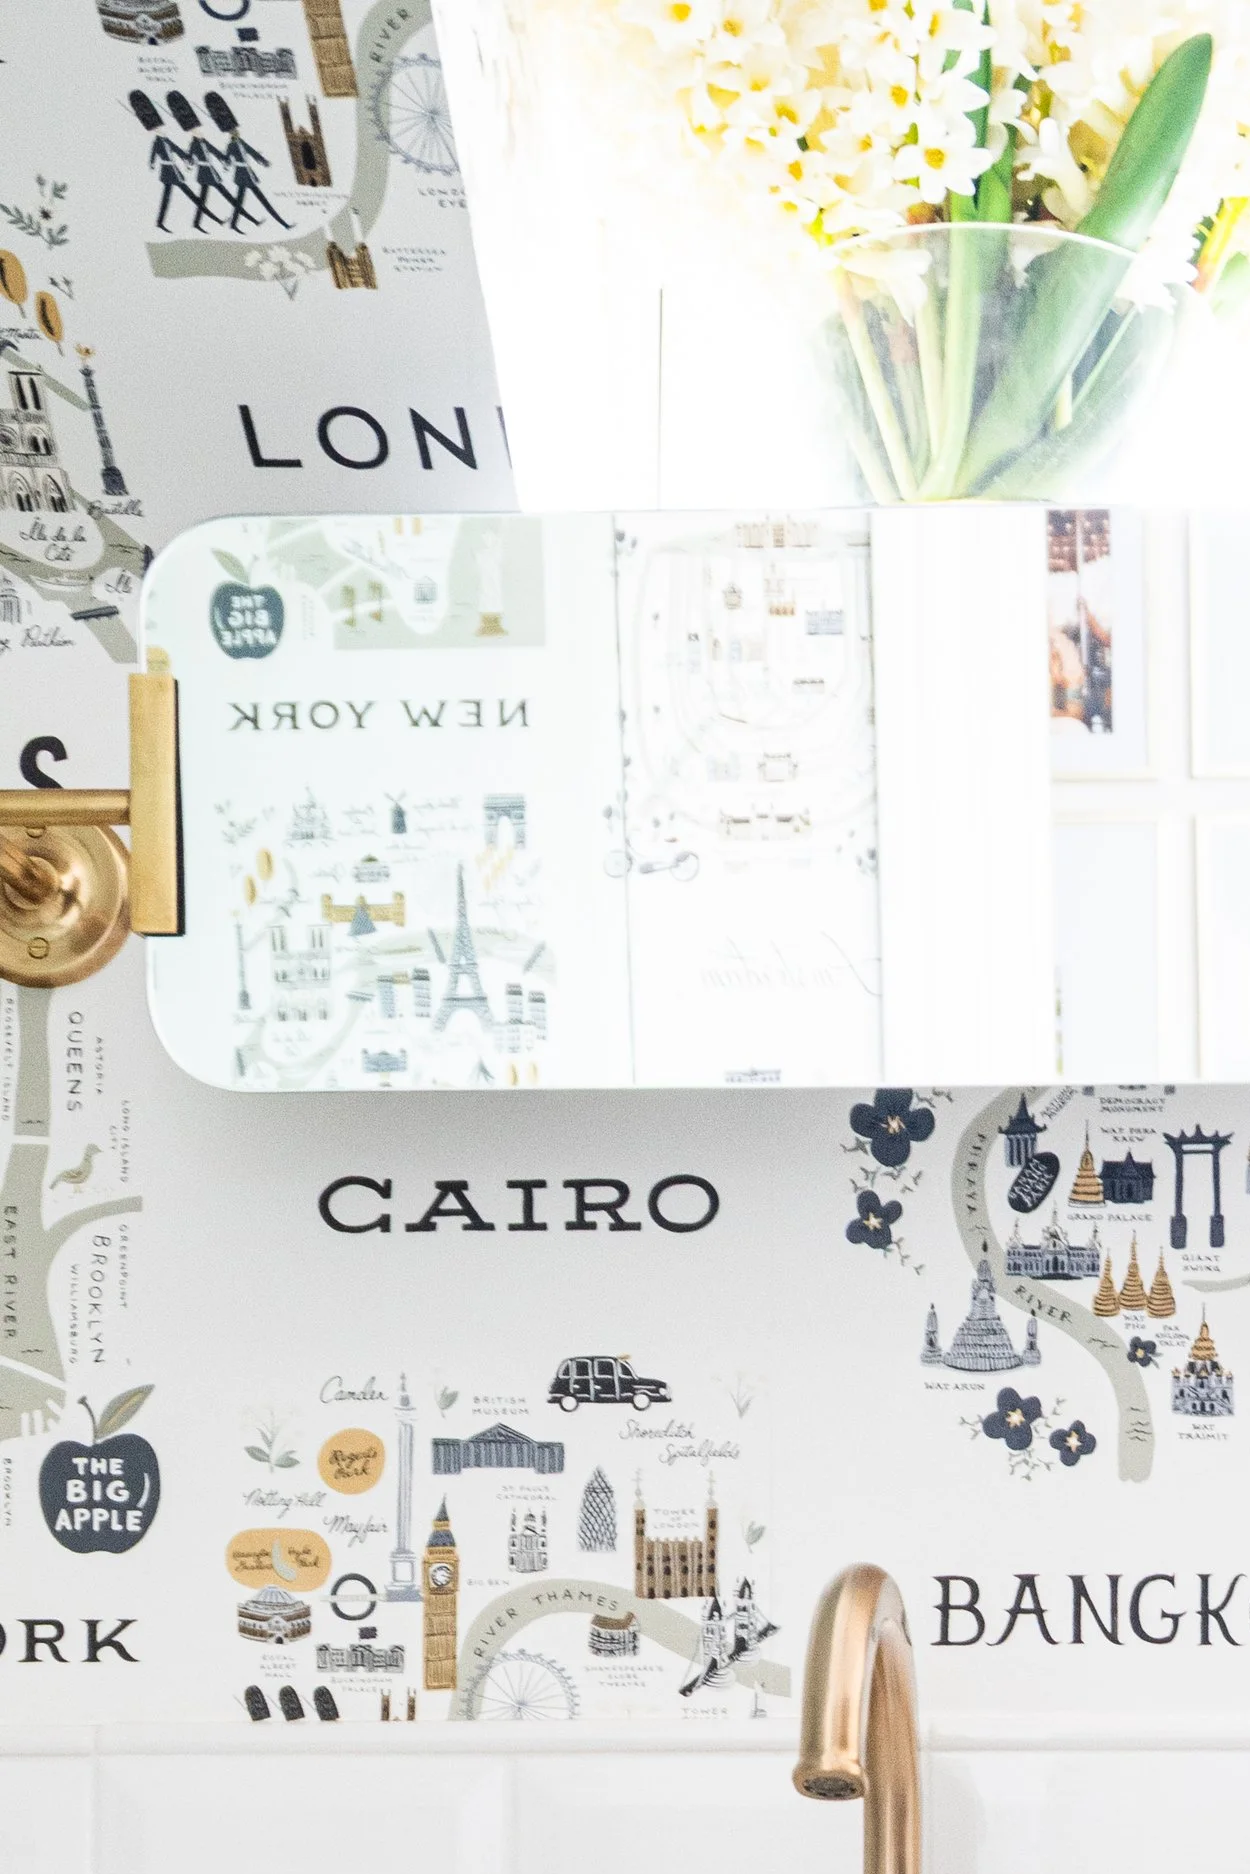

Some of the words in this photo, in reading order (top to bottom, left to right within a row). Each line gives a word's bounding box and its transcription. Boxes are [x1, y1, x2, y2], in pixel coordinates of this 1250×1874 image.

[368, 7, 412, 64] RIVER
[238, 404, 513, 469] LON
[66, 1010, 85, 1113] QUEENS
[317, 1174, 720, 1234] CAIRO
[4, 1205, 18, 1260] EAST
[3, 1275, 18, 1340] RIVER
[88, 1234, 112, 1364] BROOKLYN
[1014, 1284, 1074, 1325] RIVER
[319, 1375, 390, 1404] Camden
[472, 1407, 530, 1415] MUSEUM
[473, 1396, 526, 1404] BRITISH
[71, 1458, 126, 1476] THE
[65, 1479, 131, 1503] BIG
[54, 1507, 145, 1532] APPLE
[322, 1514, 389, 1548] Mayfair
[0, 1619, 141, 1663] RK
[473, 1607, 519, 1657] RIVER
[531, 1590, 619, 1613] THAMES
